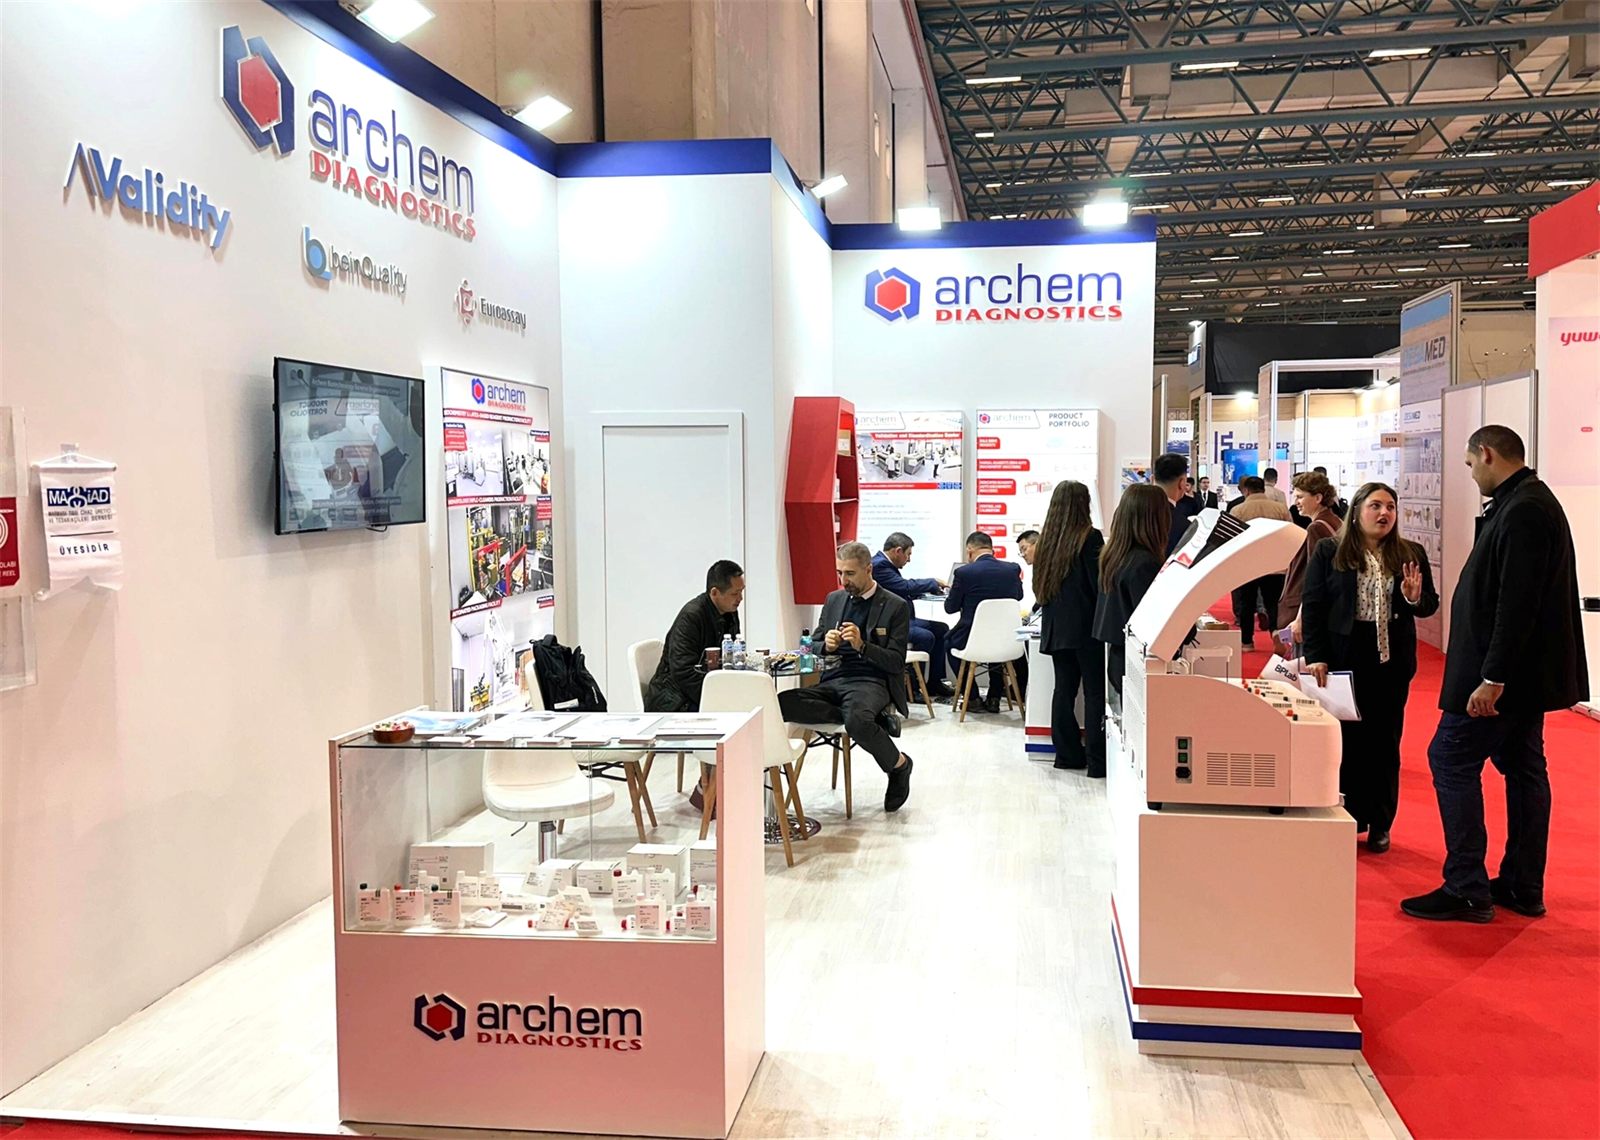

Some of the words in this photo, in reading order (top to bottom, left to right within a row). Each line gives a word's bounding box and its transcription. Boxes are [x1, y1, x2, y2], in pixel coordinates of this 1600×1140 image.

[310, 89, 475, 214] archem
[89, 146, 231, 249] Validity
[310, 150, 477, 238] DIAGNOSTICS
[331, 245, 408, 294] beinQuality
[935, 263, 1123, 305] archem
[480, 298, 527, 330] Euroassay
[935, 305, 1123, 322] DIAGNOSTICS
[1561, 332, 1600, 347] yuw
[487, 383, 527, 404] archem
[487, 400, 527, 411] DIAGNOSTICS
[1048, 412, 1083, 420] PRODUCT
[1048, 420, 1090, 428] PORTFOLIO
[59, 542, 110, 556] ÜYESİDİR
[1274, 664, 1298, 682] BPLab
[477, 995, 642, 1036] archem
[477, 1032, 642, 1051] DIAGNOSTICS
